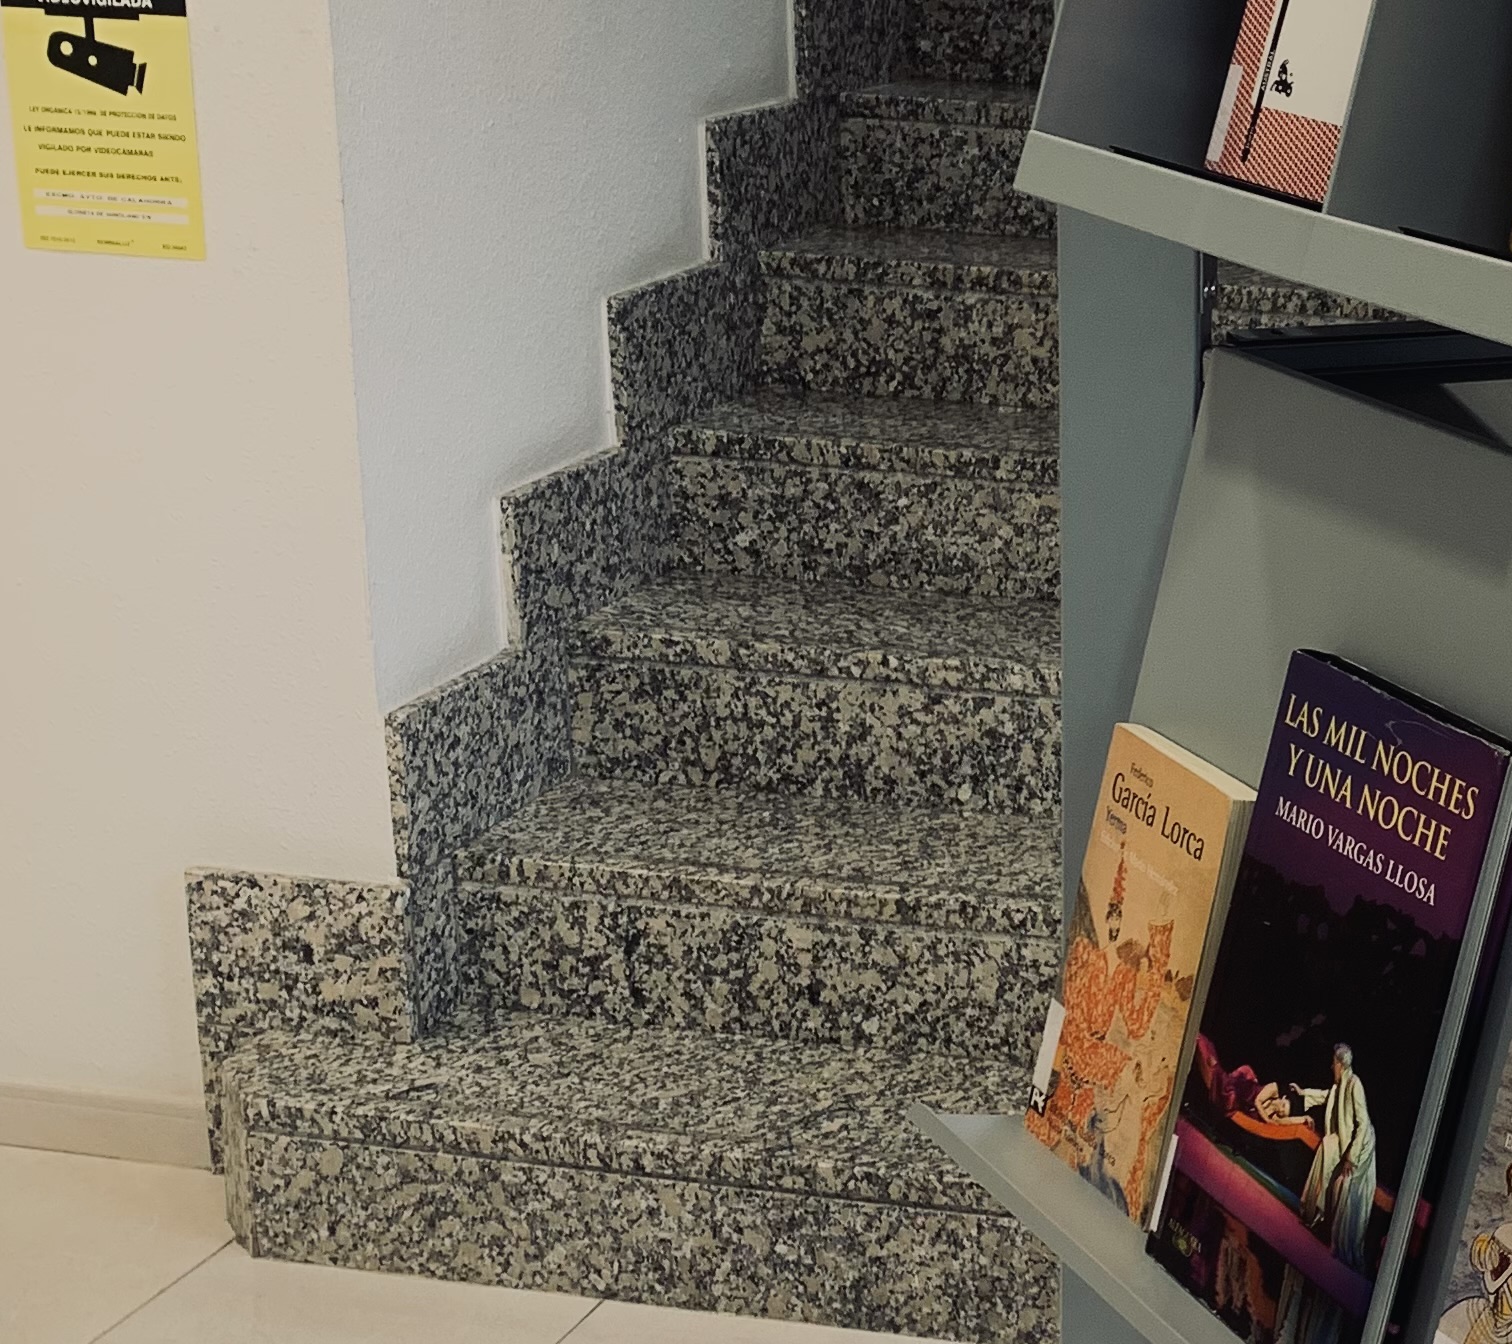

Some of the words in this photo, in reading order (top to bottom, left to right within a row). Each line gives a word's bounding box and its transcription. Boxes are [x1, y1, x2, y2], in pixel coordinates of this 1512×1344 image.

[38, 143, 74, 152] VIGILADO
[88, 128, 103, 137] QUE
[133, 131, 156, 140] ESTAR
[1284, 693, 1323, 738] LAS
[1322, 715, 1367, 764] MIL
[1371, 739, 1480, 820] NOCHES
[1288, 743, 1305, 777] Y
[1304, 754, 1353, 810] UNA
[1357, 783, 1452, 861] NOCHE
[1112, 773, 1157, 827] García
[1160, 806, 1205, 862] Lorca
[1275, 796, 1325, 840] MARIO
[1326, 825, 1386, 875] VARGAS
[1385, 859, 1436, 906] LLOSA
